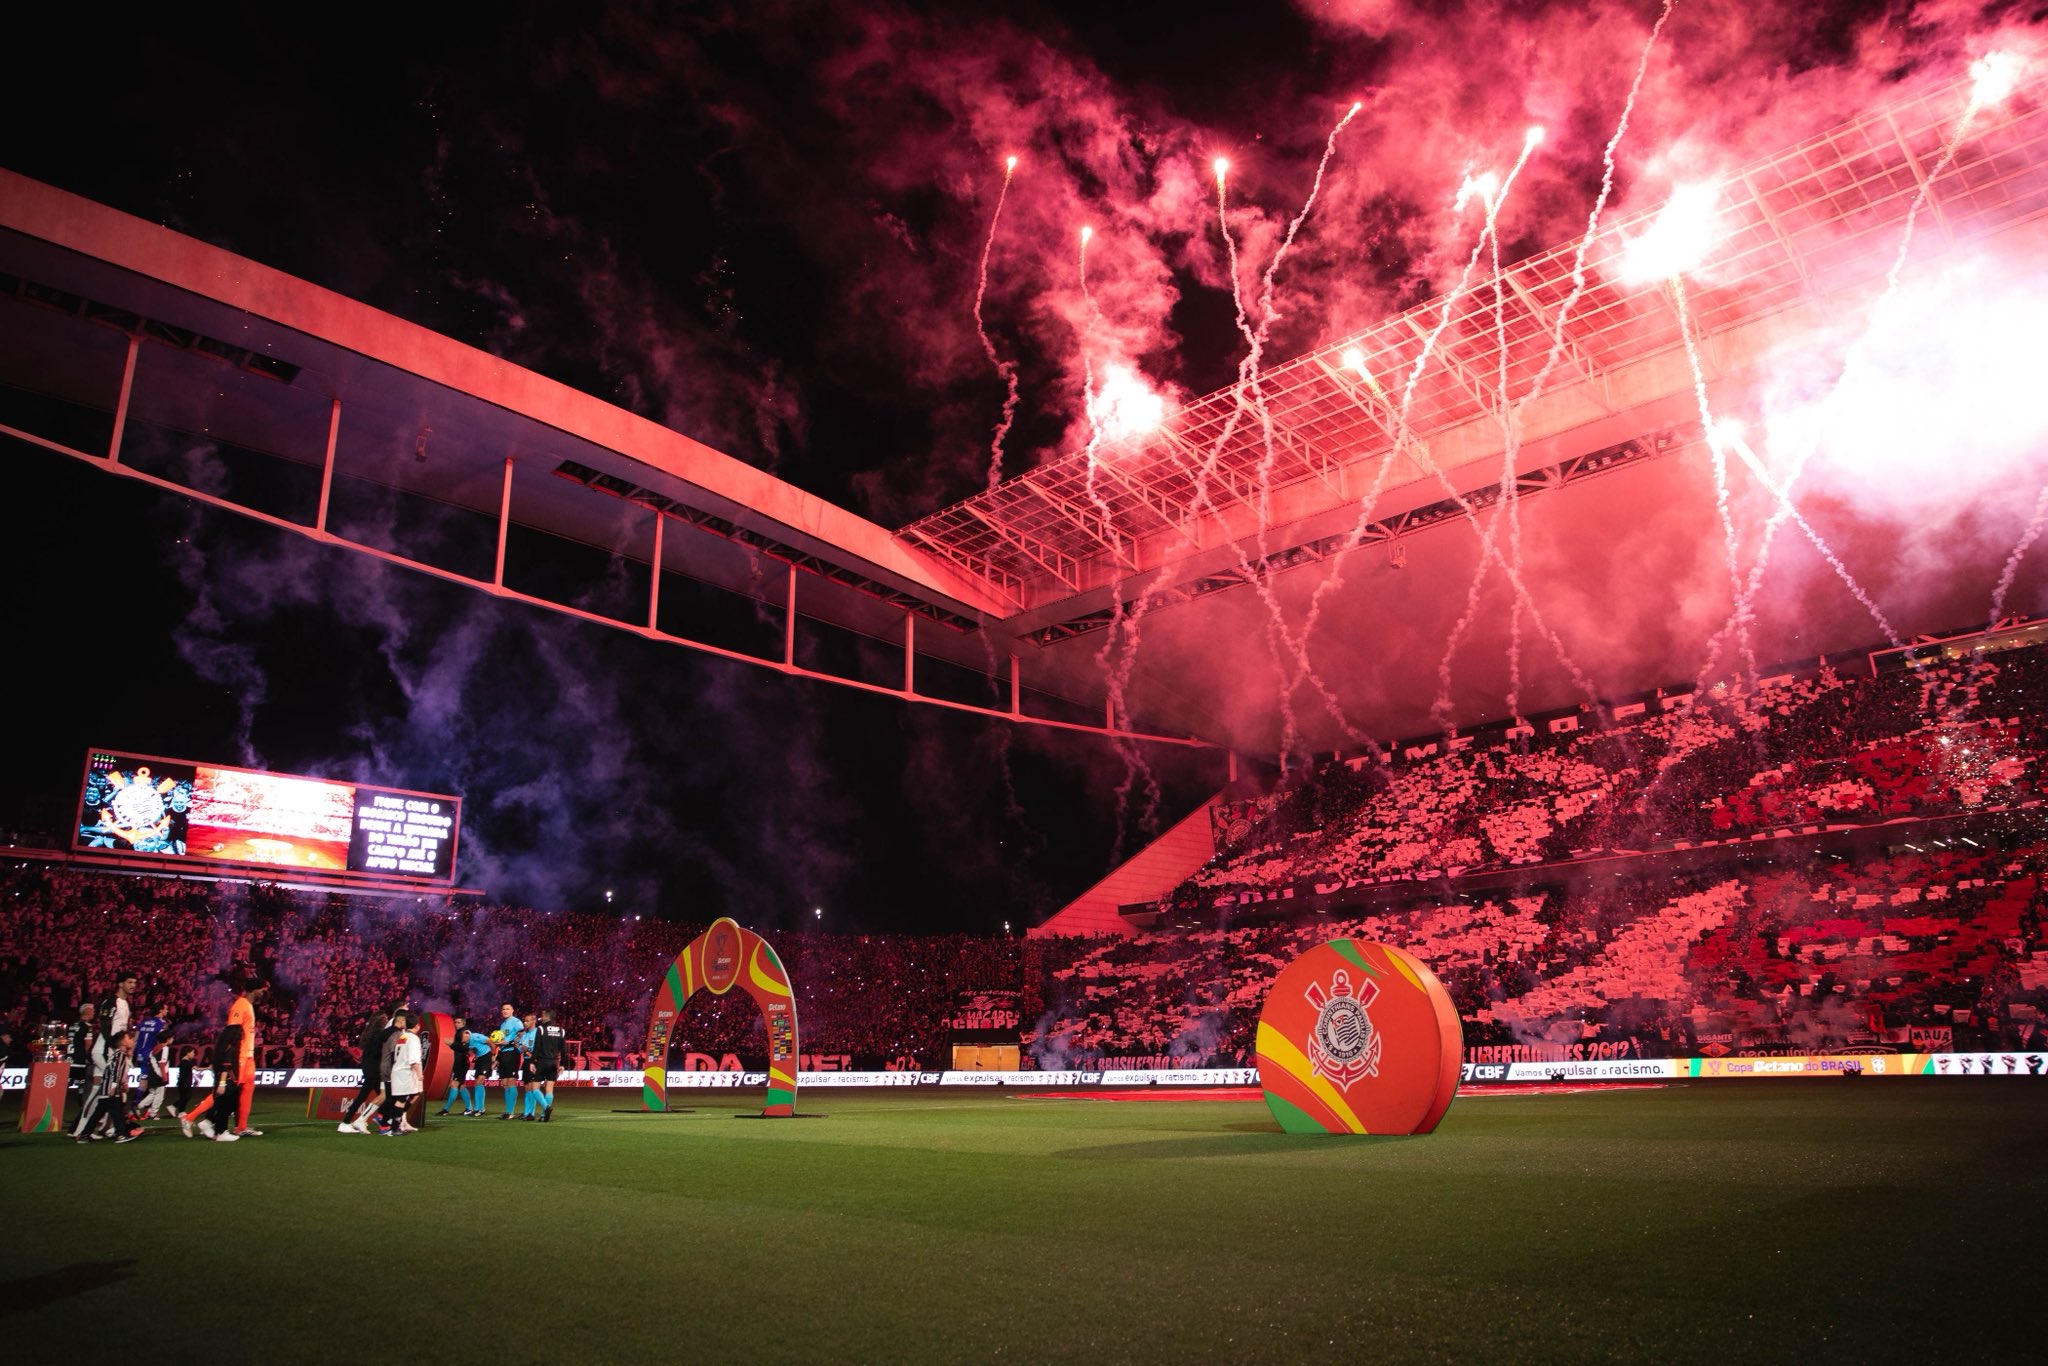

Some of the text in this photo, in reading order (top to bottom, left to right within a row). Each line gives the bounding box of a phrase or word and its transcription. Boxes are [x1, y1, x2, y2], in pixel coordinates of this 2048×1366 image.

[1322, 1002, 1355, 1034] CORINTHIANS
[1545, 1064, 1598, 1077] expulsar
[1609, 1064, 1664, 1075] racismo.
[1727, 1060, 1864, 1073] Copa Betano do BRASIL
[921, 1073, 939, 1083] CBF
[1081, 1072, 1101, 1083] CBF
[1125, 1072, 1158, 1083] expulsar
[1165, 1072, 1200, 1081] racismo.
[1475, 1066, 1504, 1079] CBF
[298, 1075, 328, 1083] Vamos
[743, 1073, 766, 1085] CBF
[838, 1075, 871, 1083] racismo.
[964, 1074, 1003, 1083] expulsar
